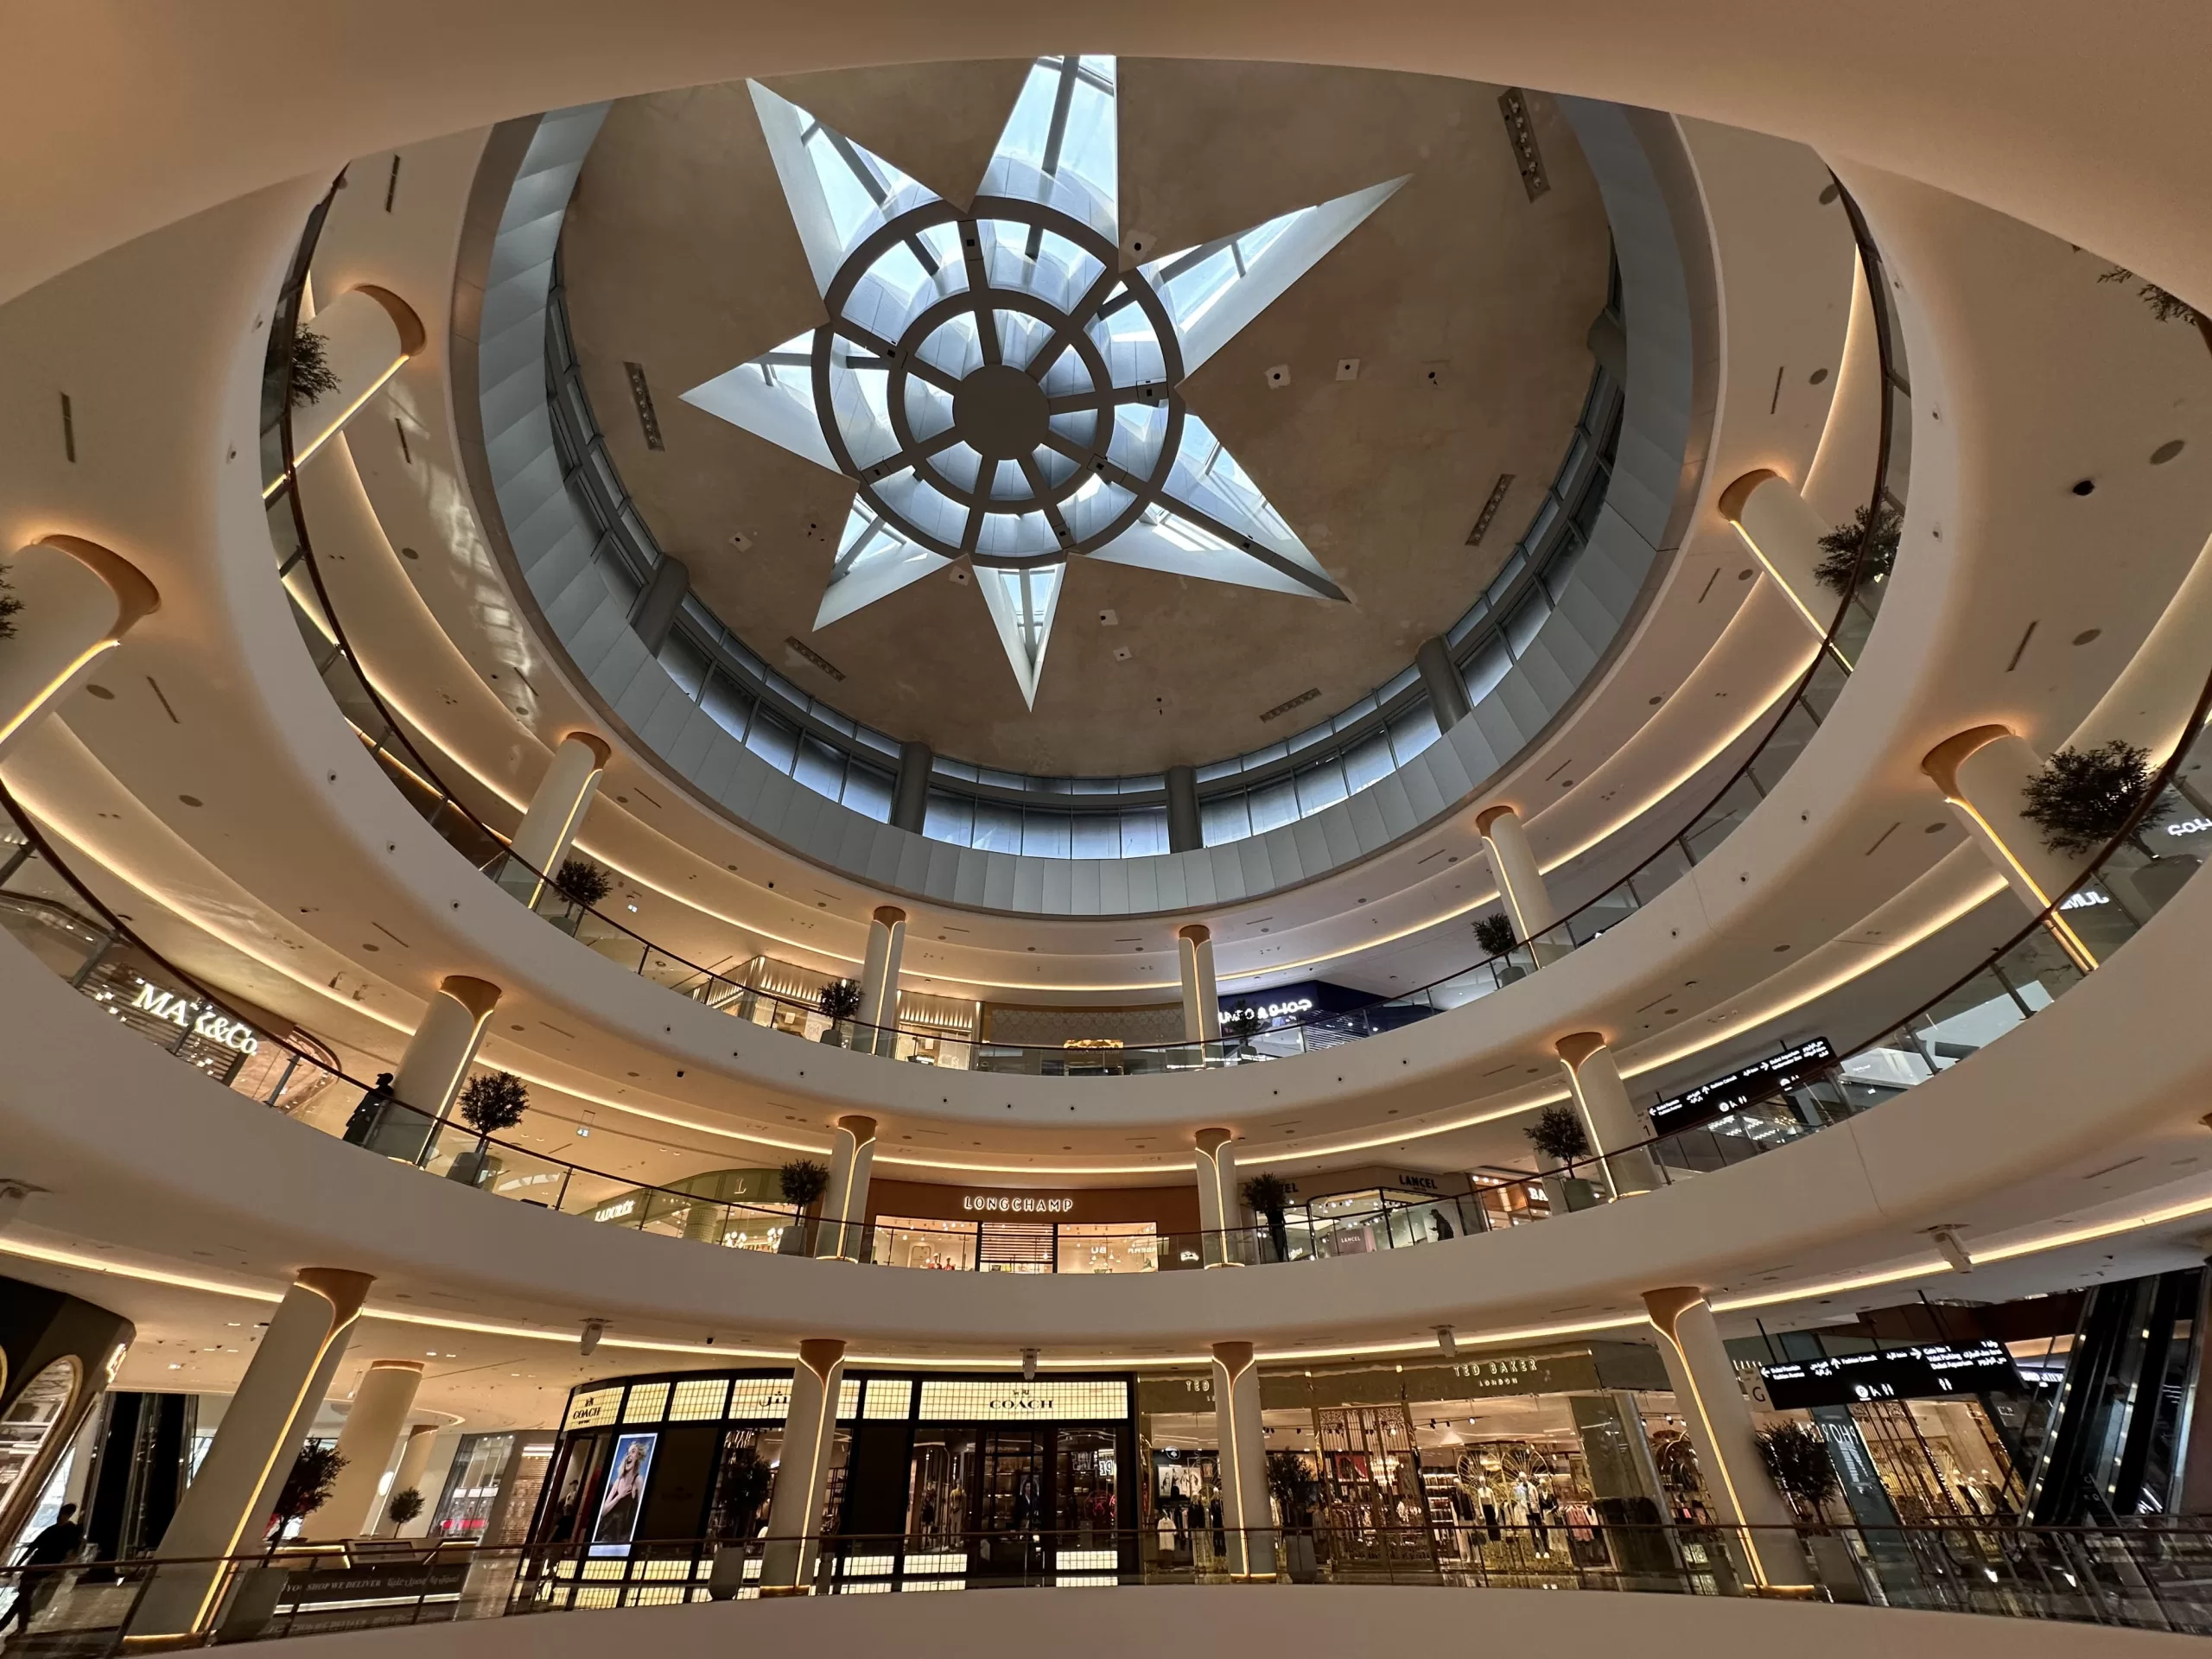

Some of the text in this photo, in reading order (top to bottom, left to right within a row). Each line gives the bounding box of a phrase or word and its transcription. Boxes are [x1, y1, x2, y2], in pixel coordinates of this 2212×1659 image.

[1399, 1174, 1439, 1190] LANCEL
[963, 1196, 1073, 1212] LONGCHAMP
[1453, 1357, 1538, 1376] TED BAKER
[1185, 1379, 1210, 1392] TED
[1479, 1377, 1518, 1387] LONDON
[1752, 1387, 1765, 1402] G
[989, 1400, 1053, 1409] COACH
[573, 1407, 601, 1419] COACH
[307, 1582, 331, 1592] SHOP
[331, 1581, 344, 1591] WE
[345, 1579, 382, 1590] DELIVER
